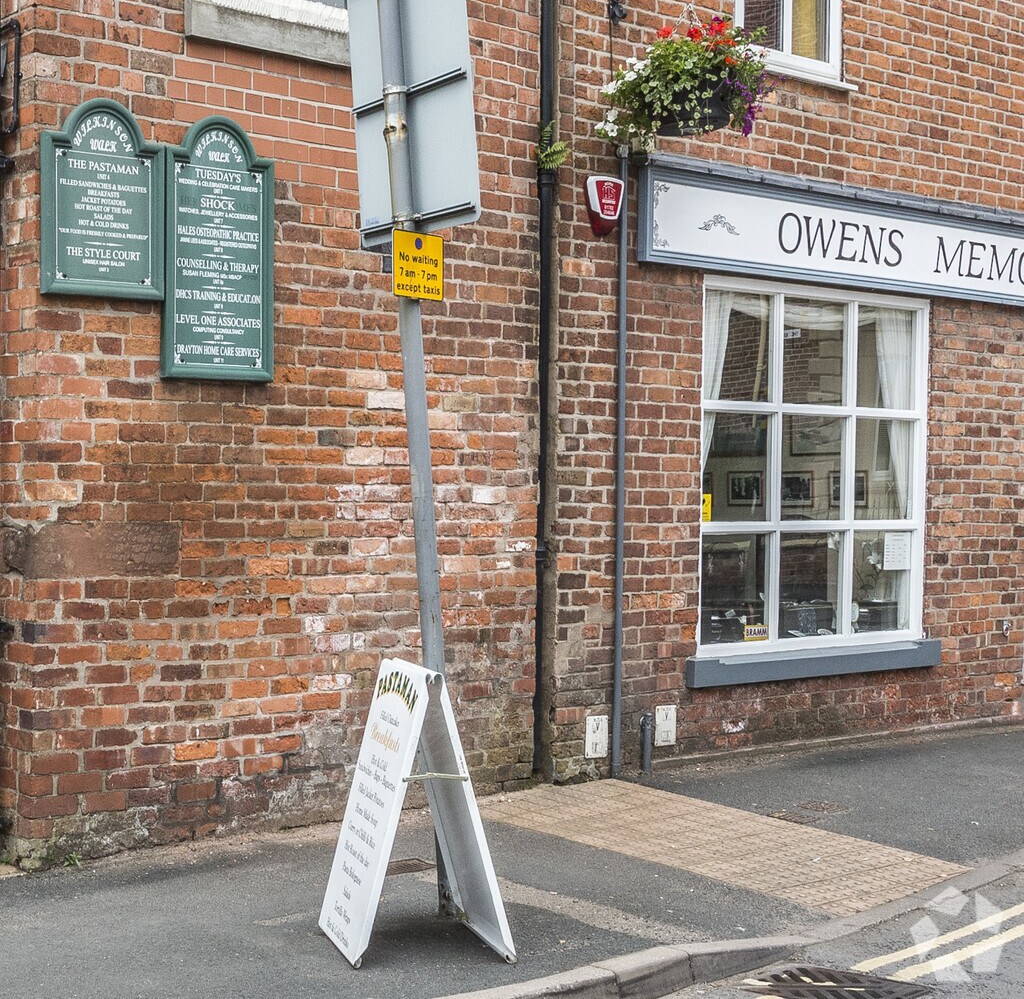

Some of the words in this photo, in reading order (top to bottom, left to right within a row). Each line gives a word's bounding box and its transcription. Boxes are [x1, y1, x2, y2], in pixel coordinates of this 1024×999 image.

[73, 116, 133, 152] WILKINSON
[90, 139, 117, 152] WALK
[196, 131, 243, 163] WILKINSON
[208, 151, 231, 163] WALK
[68, 158, 86, 169] THE
[89, 161, 139, 175] PASTAMAN
[195, 168, 242, 183] TUESDAY'S
[60, 178, 78, 186] FILLED
[79, 180, 111, 189] SANDWICHES
[117, 185, 147, 193] BAGUETTES
[202, 181, 229, 189] CELEBRATION
[88, 189, 119, 198] BREAKFASTS
[81, 196, 100, 204] JACKET
[101, 199, 126, 207] POTATOES
[86, 204, 102, 212] ROAST
[200, 198, 235, 211] SHOCK
[94, 213, 114, 221] SALADS
[200, 209, 224, 217] JEWELLERY
[229, 212, 258, 221] ACCESSORIES
[178, 225, 196, 236] HALES
[196, 227, 232, 239] OSTEOPATHIC
[233, 231, 259, 242] PRACTICE
[778, 212, 904, 267] OWENS
[66, 246, 83, 256] THE
[85, 248, 111, 258] STYLE
[112, 251, 141, 261] COURT
[399, 251, 409, 262] No
[412, 255, 438, 267] waiting
[177, 257, 222, 270] COUNSELLING
[223, 261, 229, 271] &
[230, 262, 259, 273] THERAPY
[176, 289, 192, 299] DHCS
[193, 290, 221, 301] TRAINING
[222, 293, 227, 302] &
[397, 283, 421, 293] except
[424, 285, 440, 295] taxis
[176, 314, 199, 324] LEVEL
[201, 315, 216, 326] ONE
[218, 317, 261, 328] ASSOCIATES
[177, 344, 203, 354] DRAYTON
[204, 345, 219, 355] HOME
[220, 346, 234, 356] CARE
[235, 347, 259, 357] SERVICES
[746, 627, 768, 637] BRAMM
[376, 670, 418, 715] PASTAMAN
